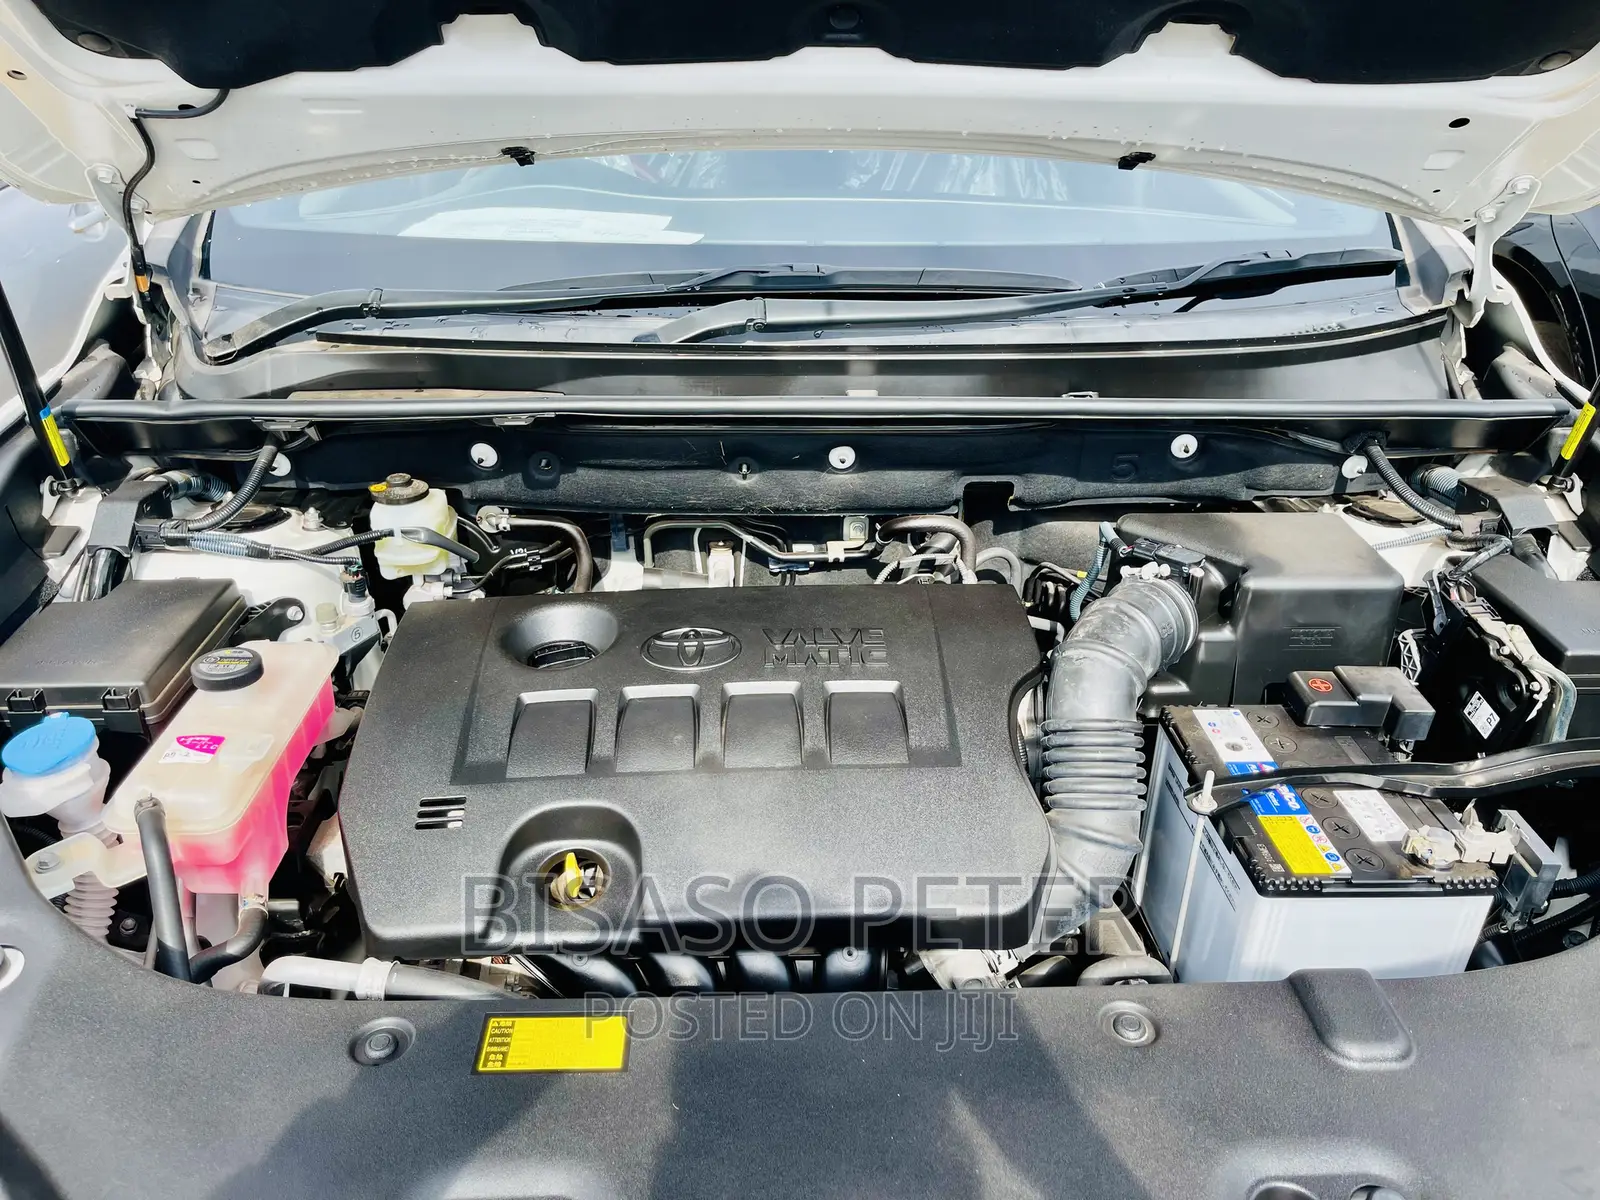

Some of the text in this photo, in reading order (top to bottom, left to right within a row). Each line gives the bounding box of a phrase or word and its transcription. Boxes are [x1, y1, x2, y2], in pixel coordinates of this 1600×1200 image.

[761, 627, 887, 646] VALVE
[763, 645, 890, 668] MATIC
[1486, 712, 1498, 727] P7
[490, 1027, 513, 1035] CAUTION
